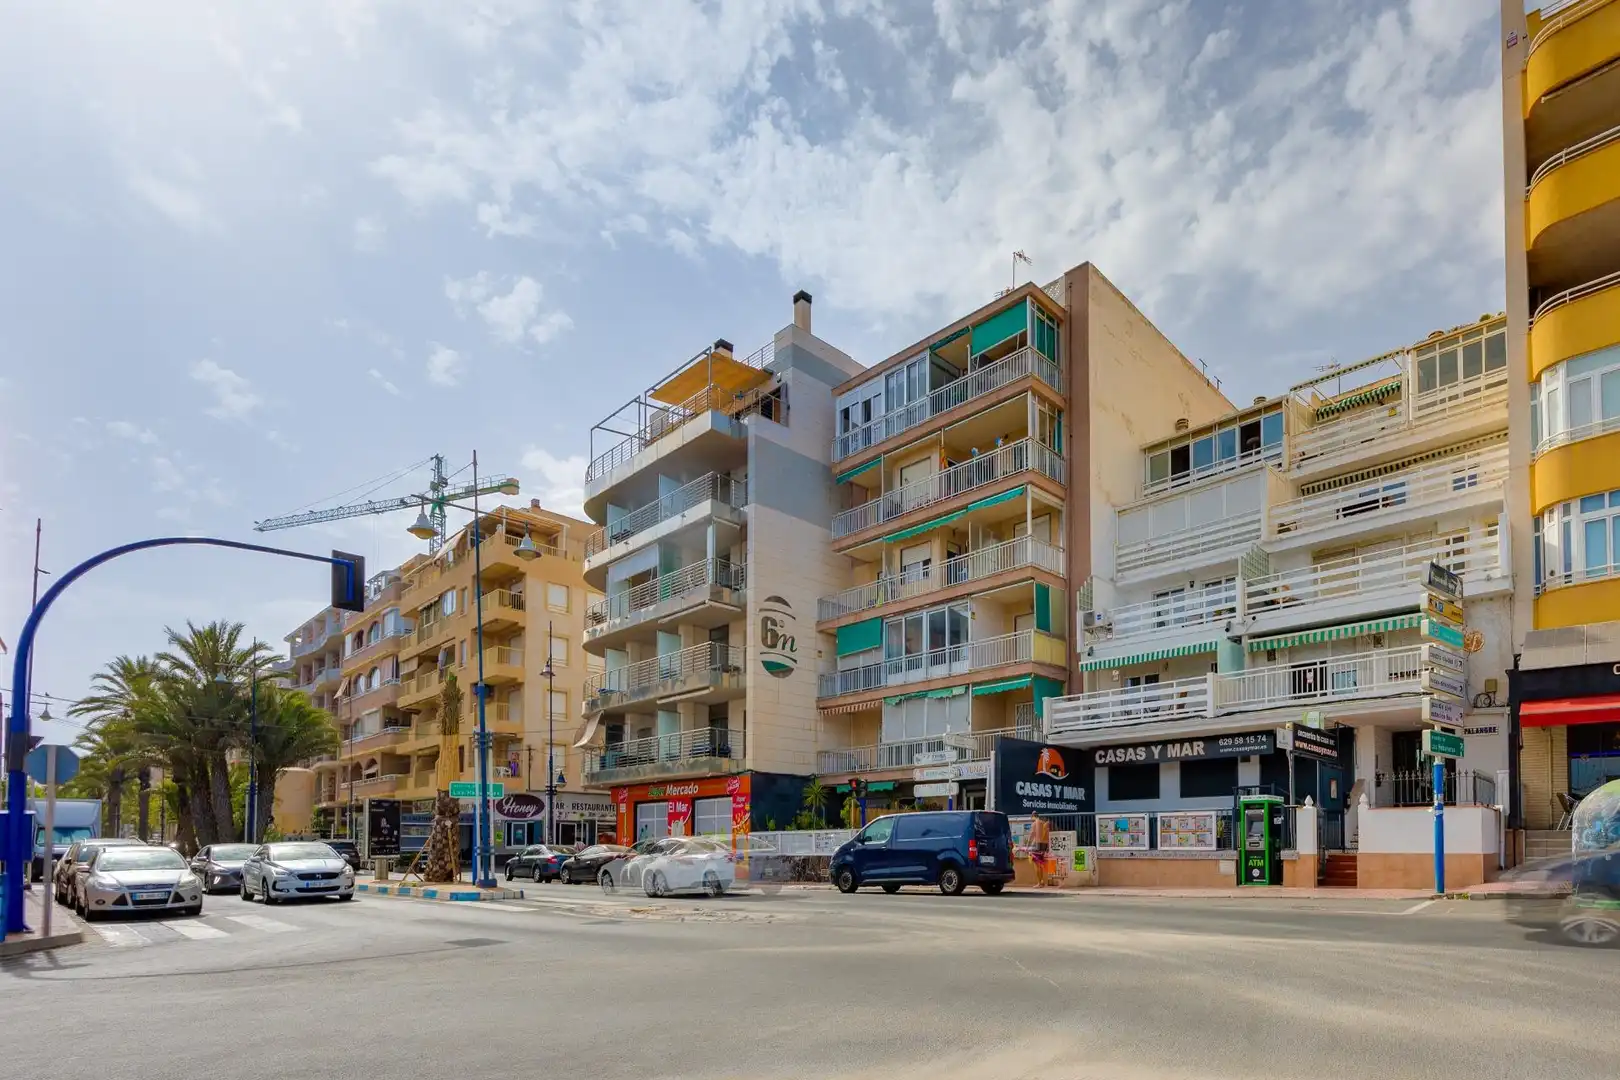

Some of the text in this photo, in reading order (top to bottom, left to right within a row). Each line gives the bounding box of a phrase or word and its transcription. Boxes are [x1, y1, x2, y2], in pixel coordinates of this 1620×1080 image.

[1218, 734, 1267, 746] 629 58 15 74
[1094, 741, 1206, 765] CASAS Y MAR
[665, 782, 704, 797] Mercado
[1015, 781, 1086, 801] CASAS Y MAR
[502, 795, 539, 818] Honey
[571, 803, 616, 812] RESTAURANTE
[668, 801, 690, 812] El Mar
[1022, 798, 1047, 809] Servicios
[1248, 859, 1264, 867] ATM
